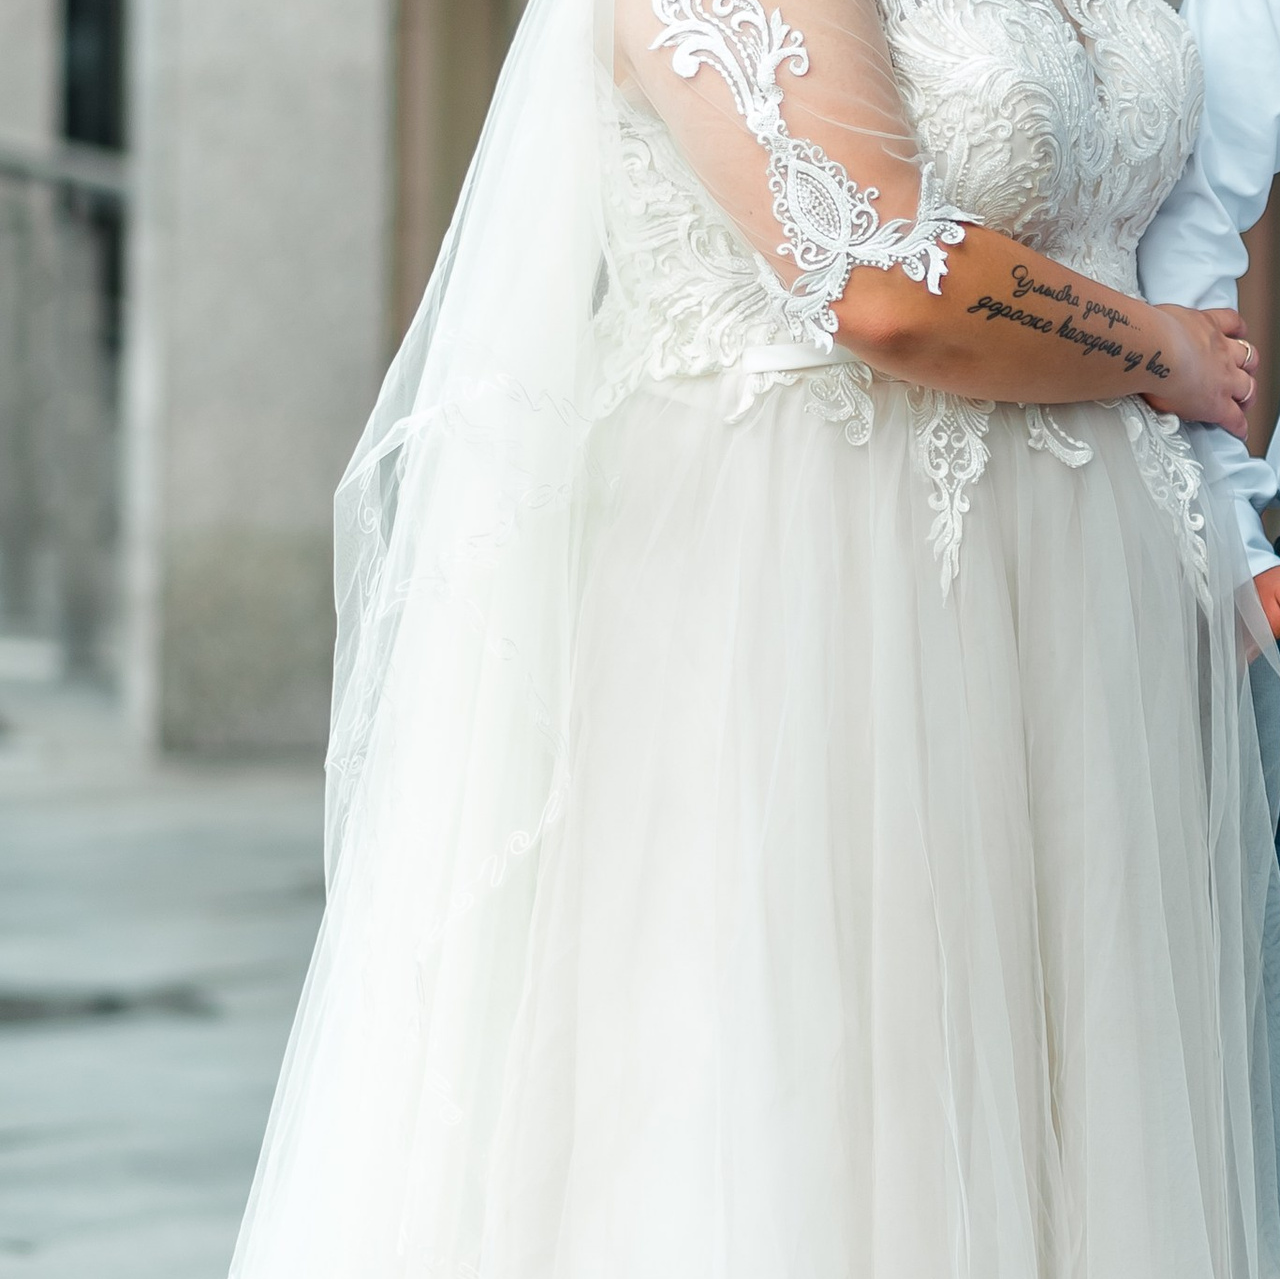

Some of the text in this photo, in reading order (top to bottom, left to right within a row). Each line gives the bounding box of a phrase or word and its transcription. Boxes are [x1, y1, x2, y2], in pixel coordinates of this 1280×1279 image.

[1012, 265, 1079, 307] Улыбка
[968, 295, 1171, 379] дороже каждого из вас
